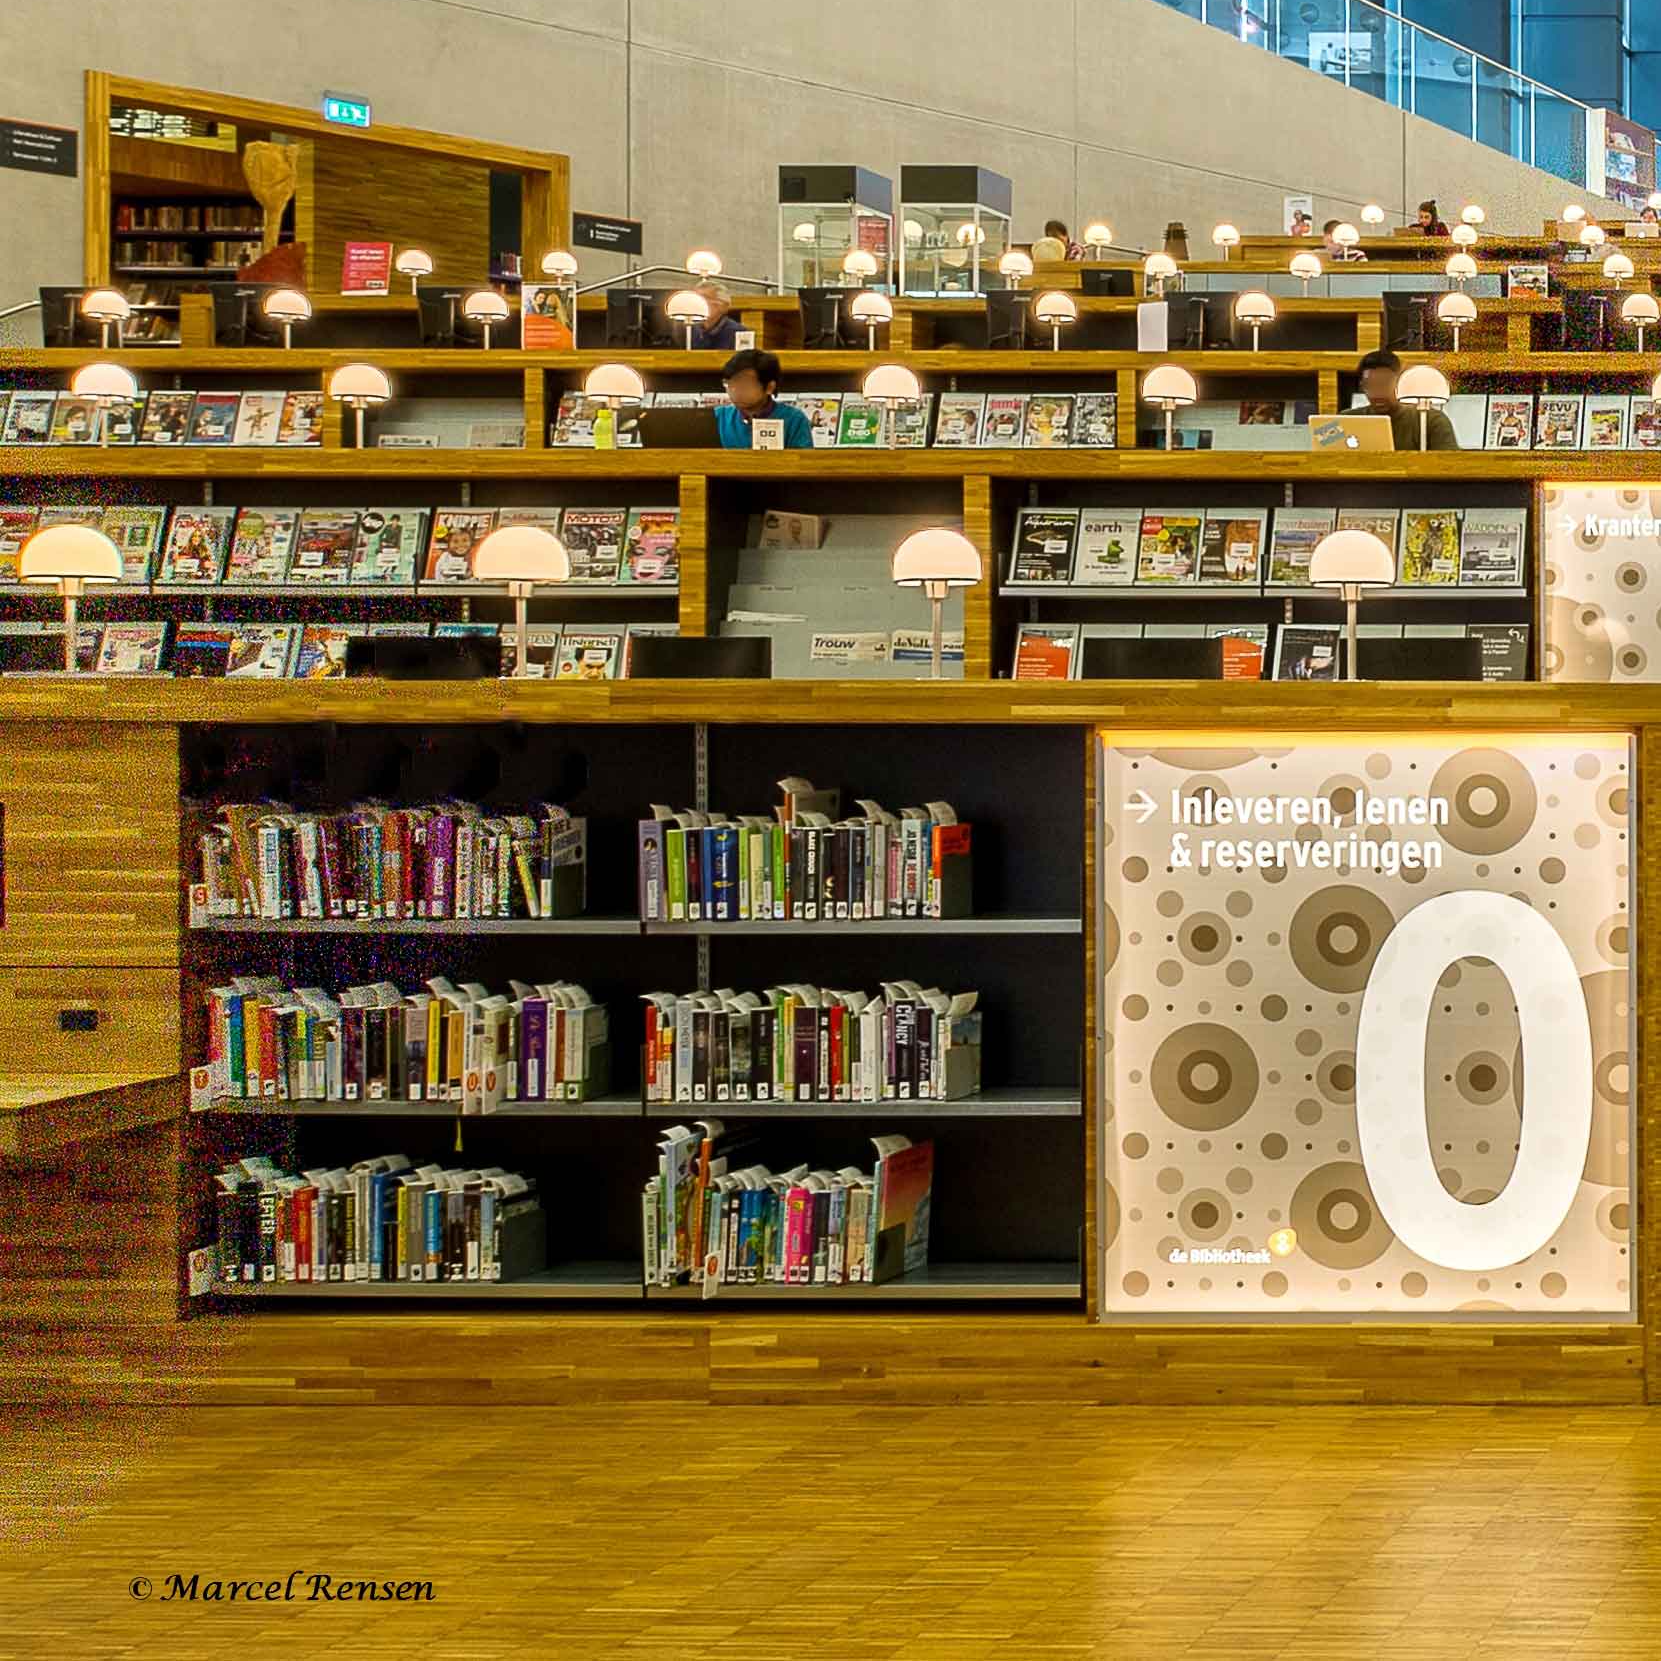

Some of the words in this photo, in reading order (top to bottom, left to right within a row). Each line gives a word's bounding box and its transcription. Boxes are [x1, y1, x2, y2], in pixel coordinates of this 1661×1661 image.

[1085, 521, 1123, 533] earth
[814, 637, 856, 649] Trouw
[1172, 788, 1343, 829] Inleveren,
[1355, 788, 1449, 825] lenen
[1170, 832, 1194, 869] &
[1201, 832, 1443, 878] reserveringen
[895, 1004, 912, 1046] CLANCY
[1355, 890, 1594, 1273] 0
[1169, 1248, 1189, 1264] de
[1190, 1248, 1272, 1264] Bibliotheek
